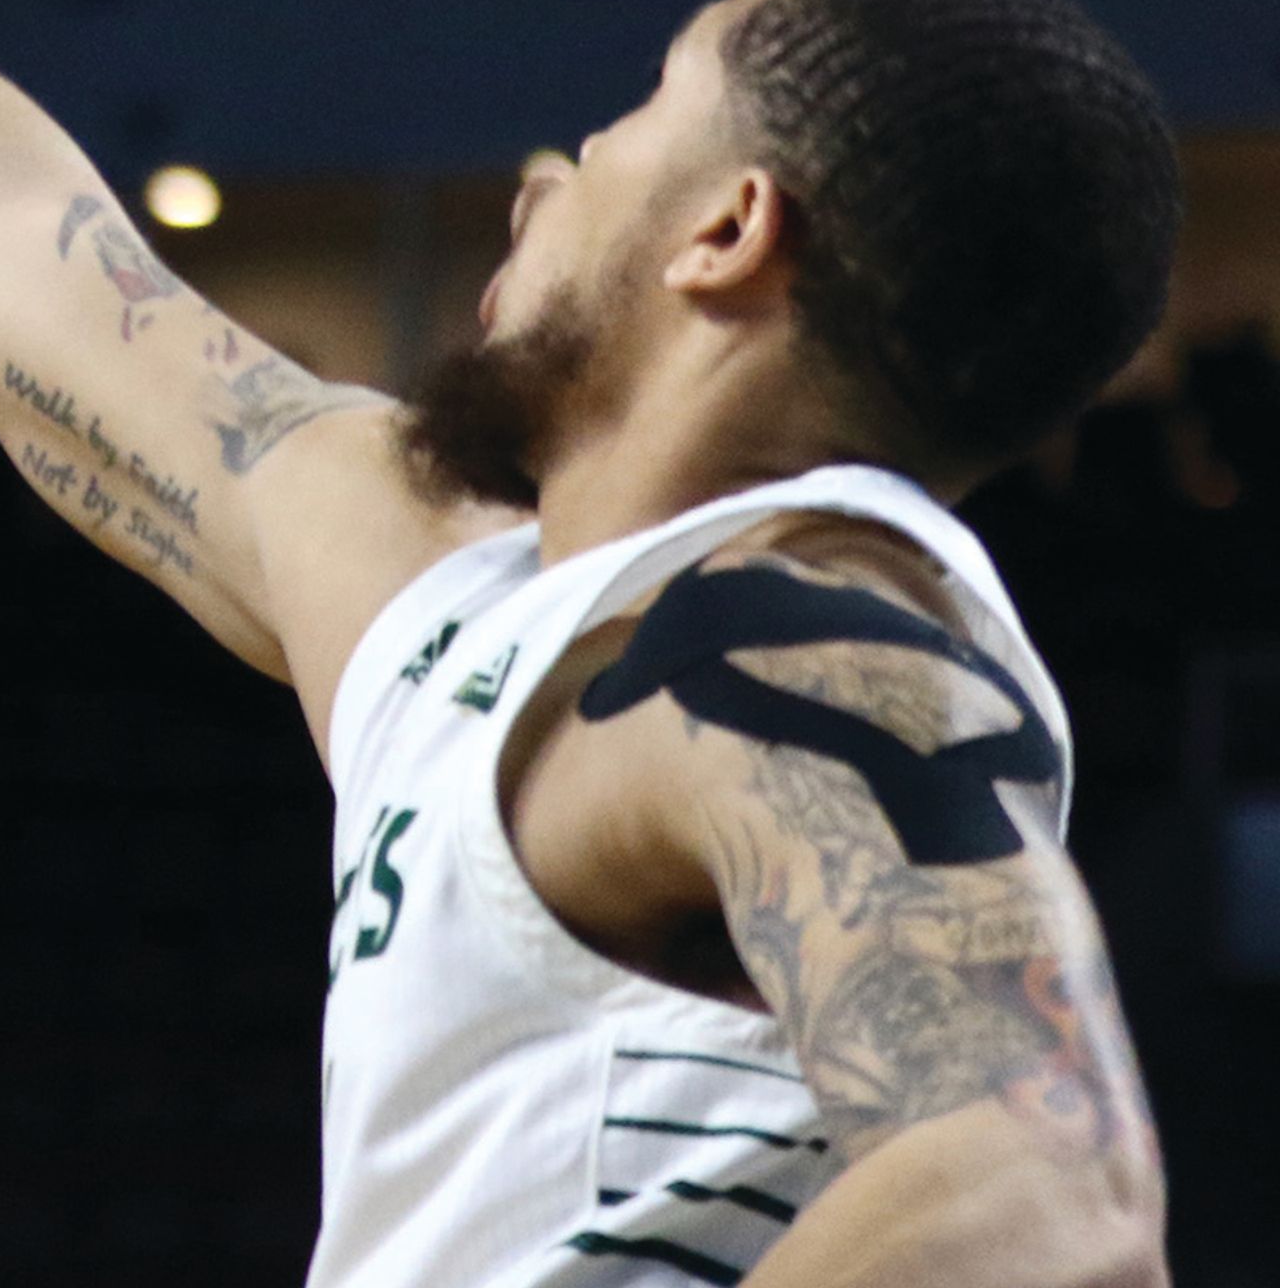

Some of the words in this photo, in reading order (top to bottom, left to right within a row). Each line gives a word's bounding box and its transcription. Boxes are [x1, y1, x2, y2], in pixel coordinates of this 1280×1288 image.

[4, 362, 78, 432] Walk
[88, 416, 117, 470] by
[21, 444, 77, 498] Not
[81, 474, 119, 530] by
